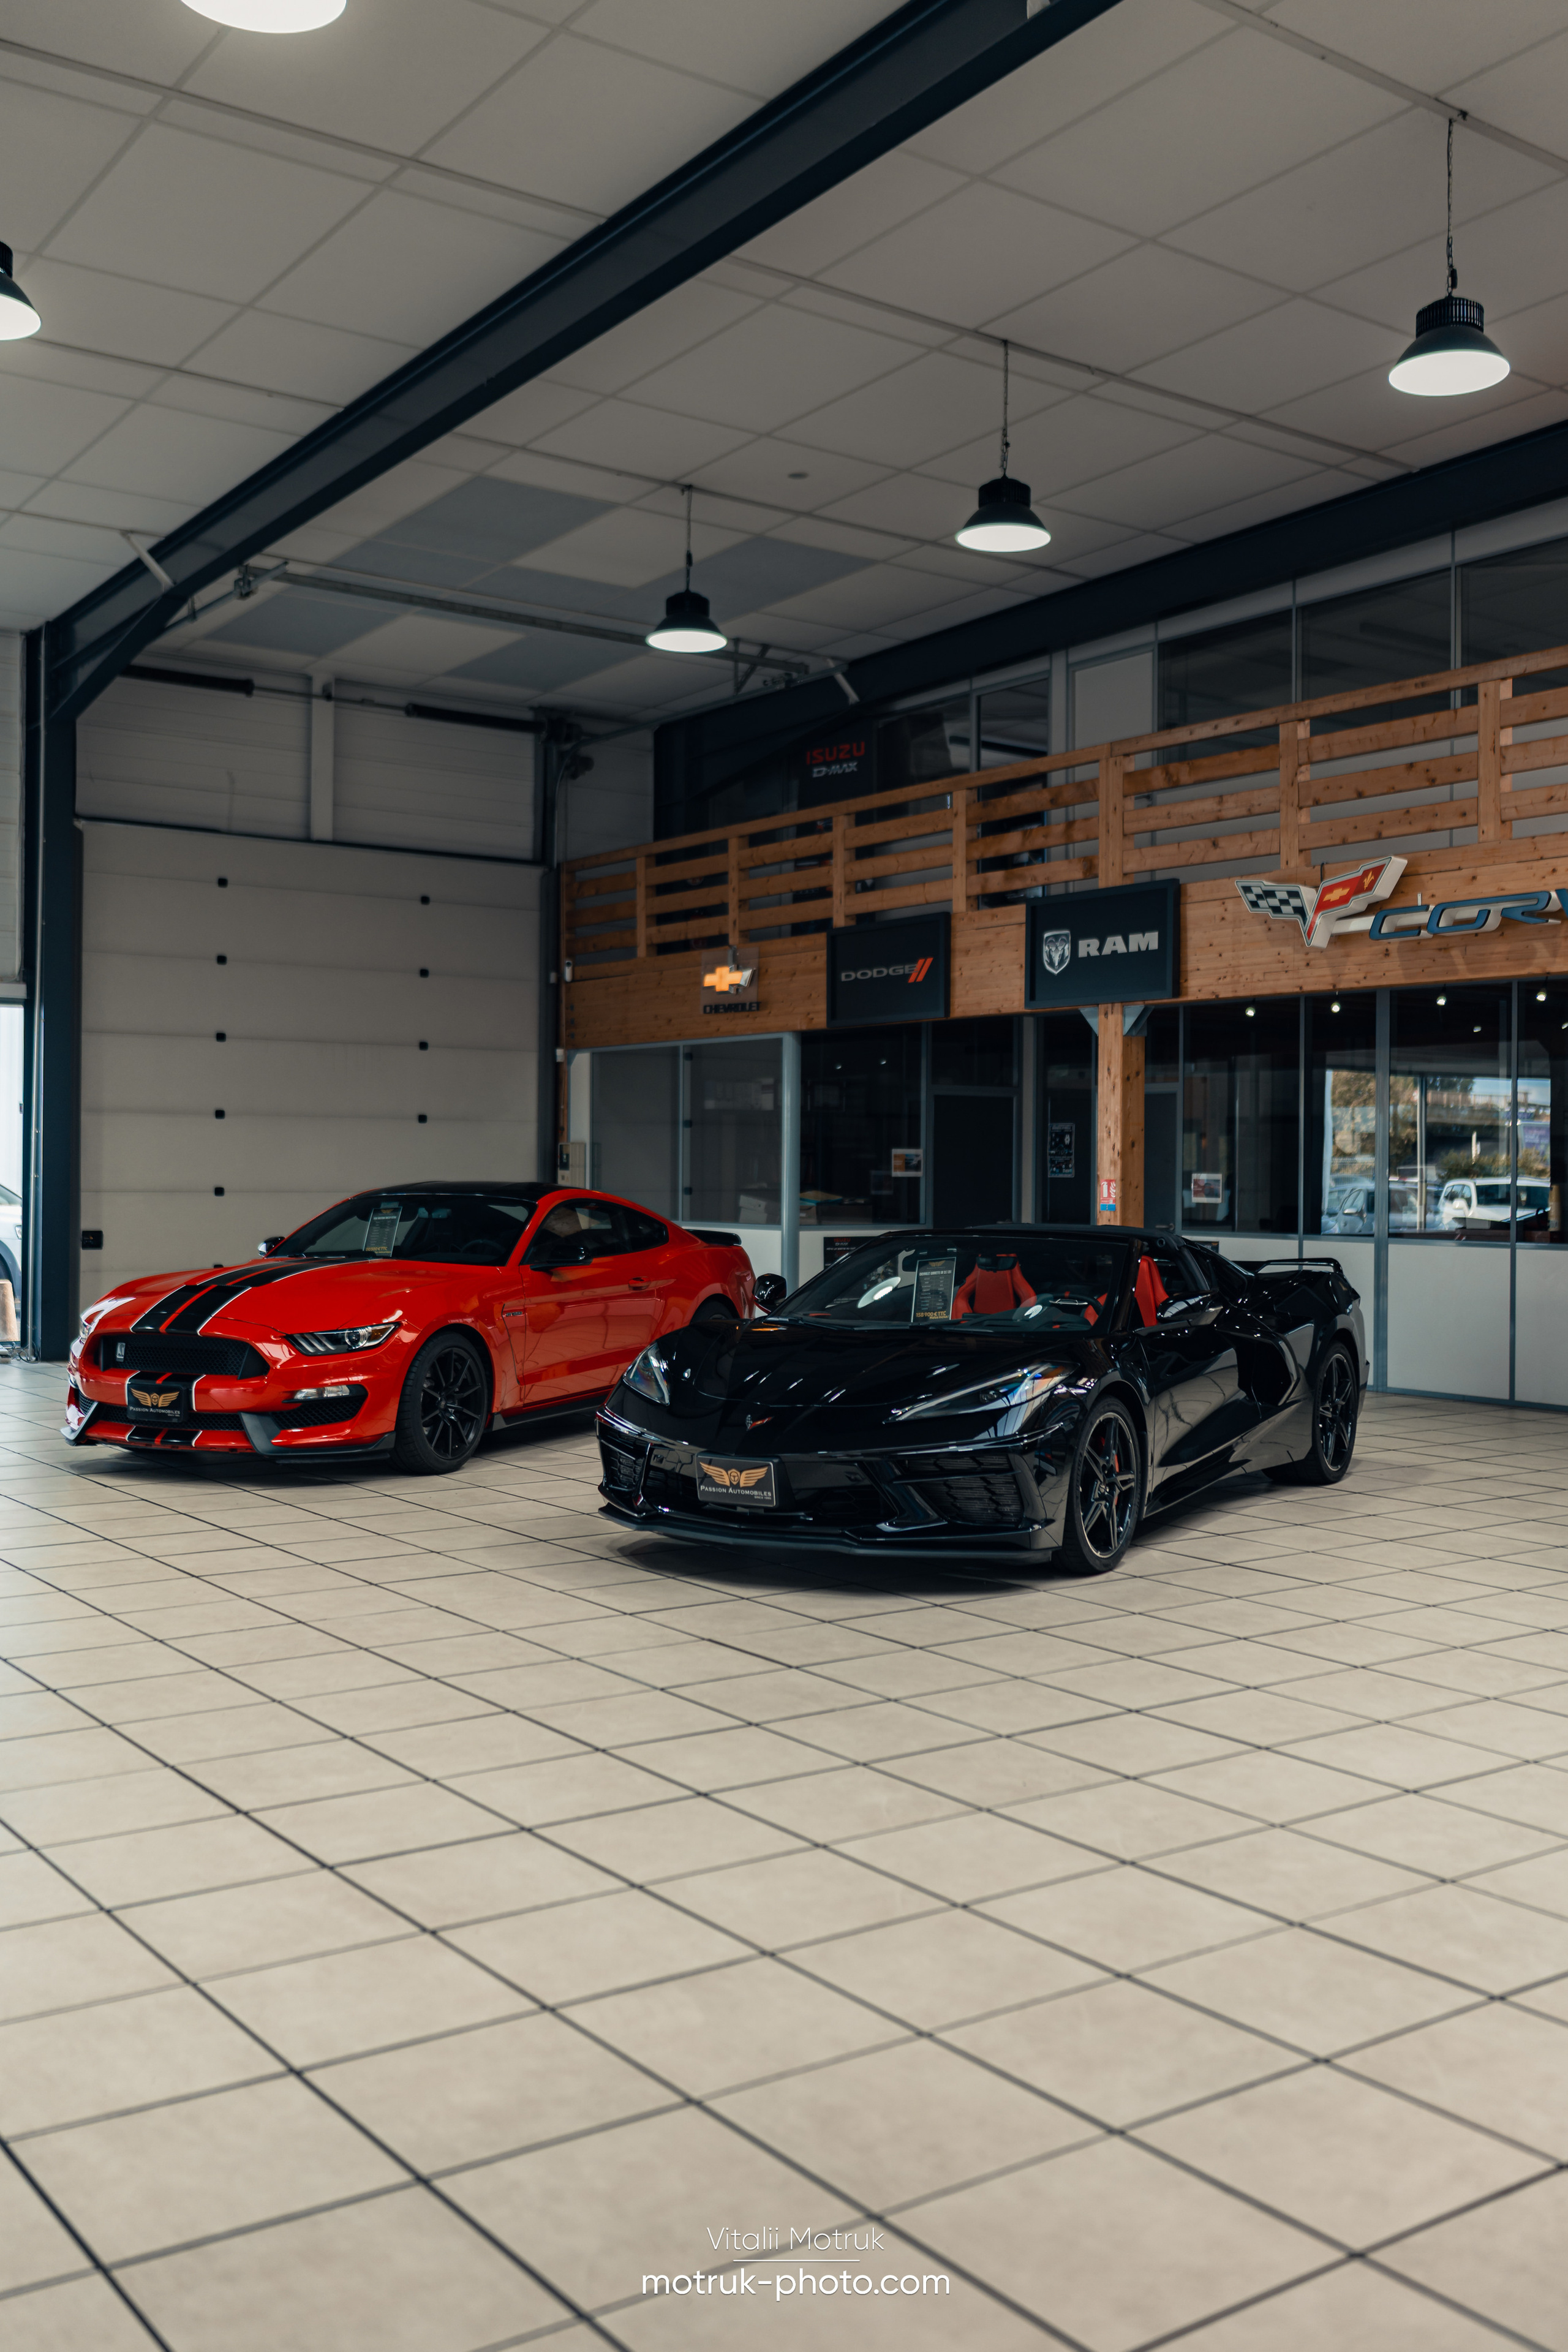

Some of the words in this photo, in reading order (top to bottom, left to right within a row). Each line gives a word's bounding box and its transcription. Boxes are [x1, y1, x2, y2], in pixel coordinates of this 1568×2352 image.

[806, 741, 865, 765] ISUZU
[1369, 889, 1568, 941] COR
[1078, 930, 1159, 958] RAM
[841, 963, 919, 982] DODGE
[703, 1001, 762, 1014] CHEVROLET
